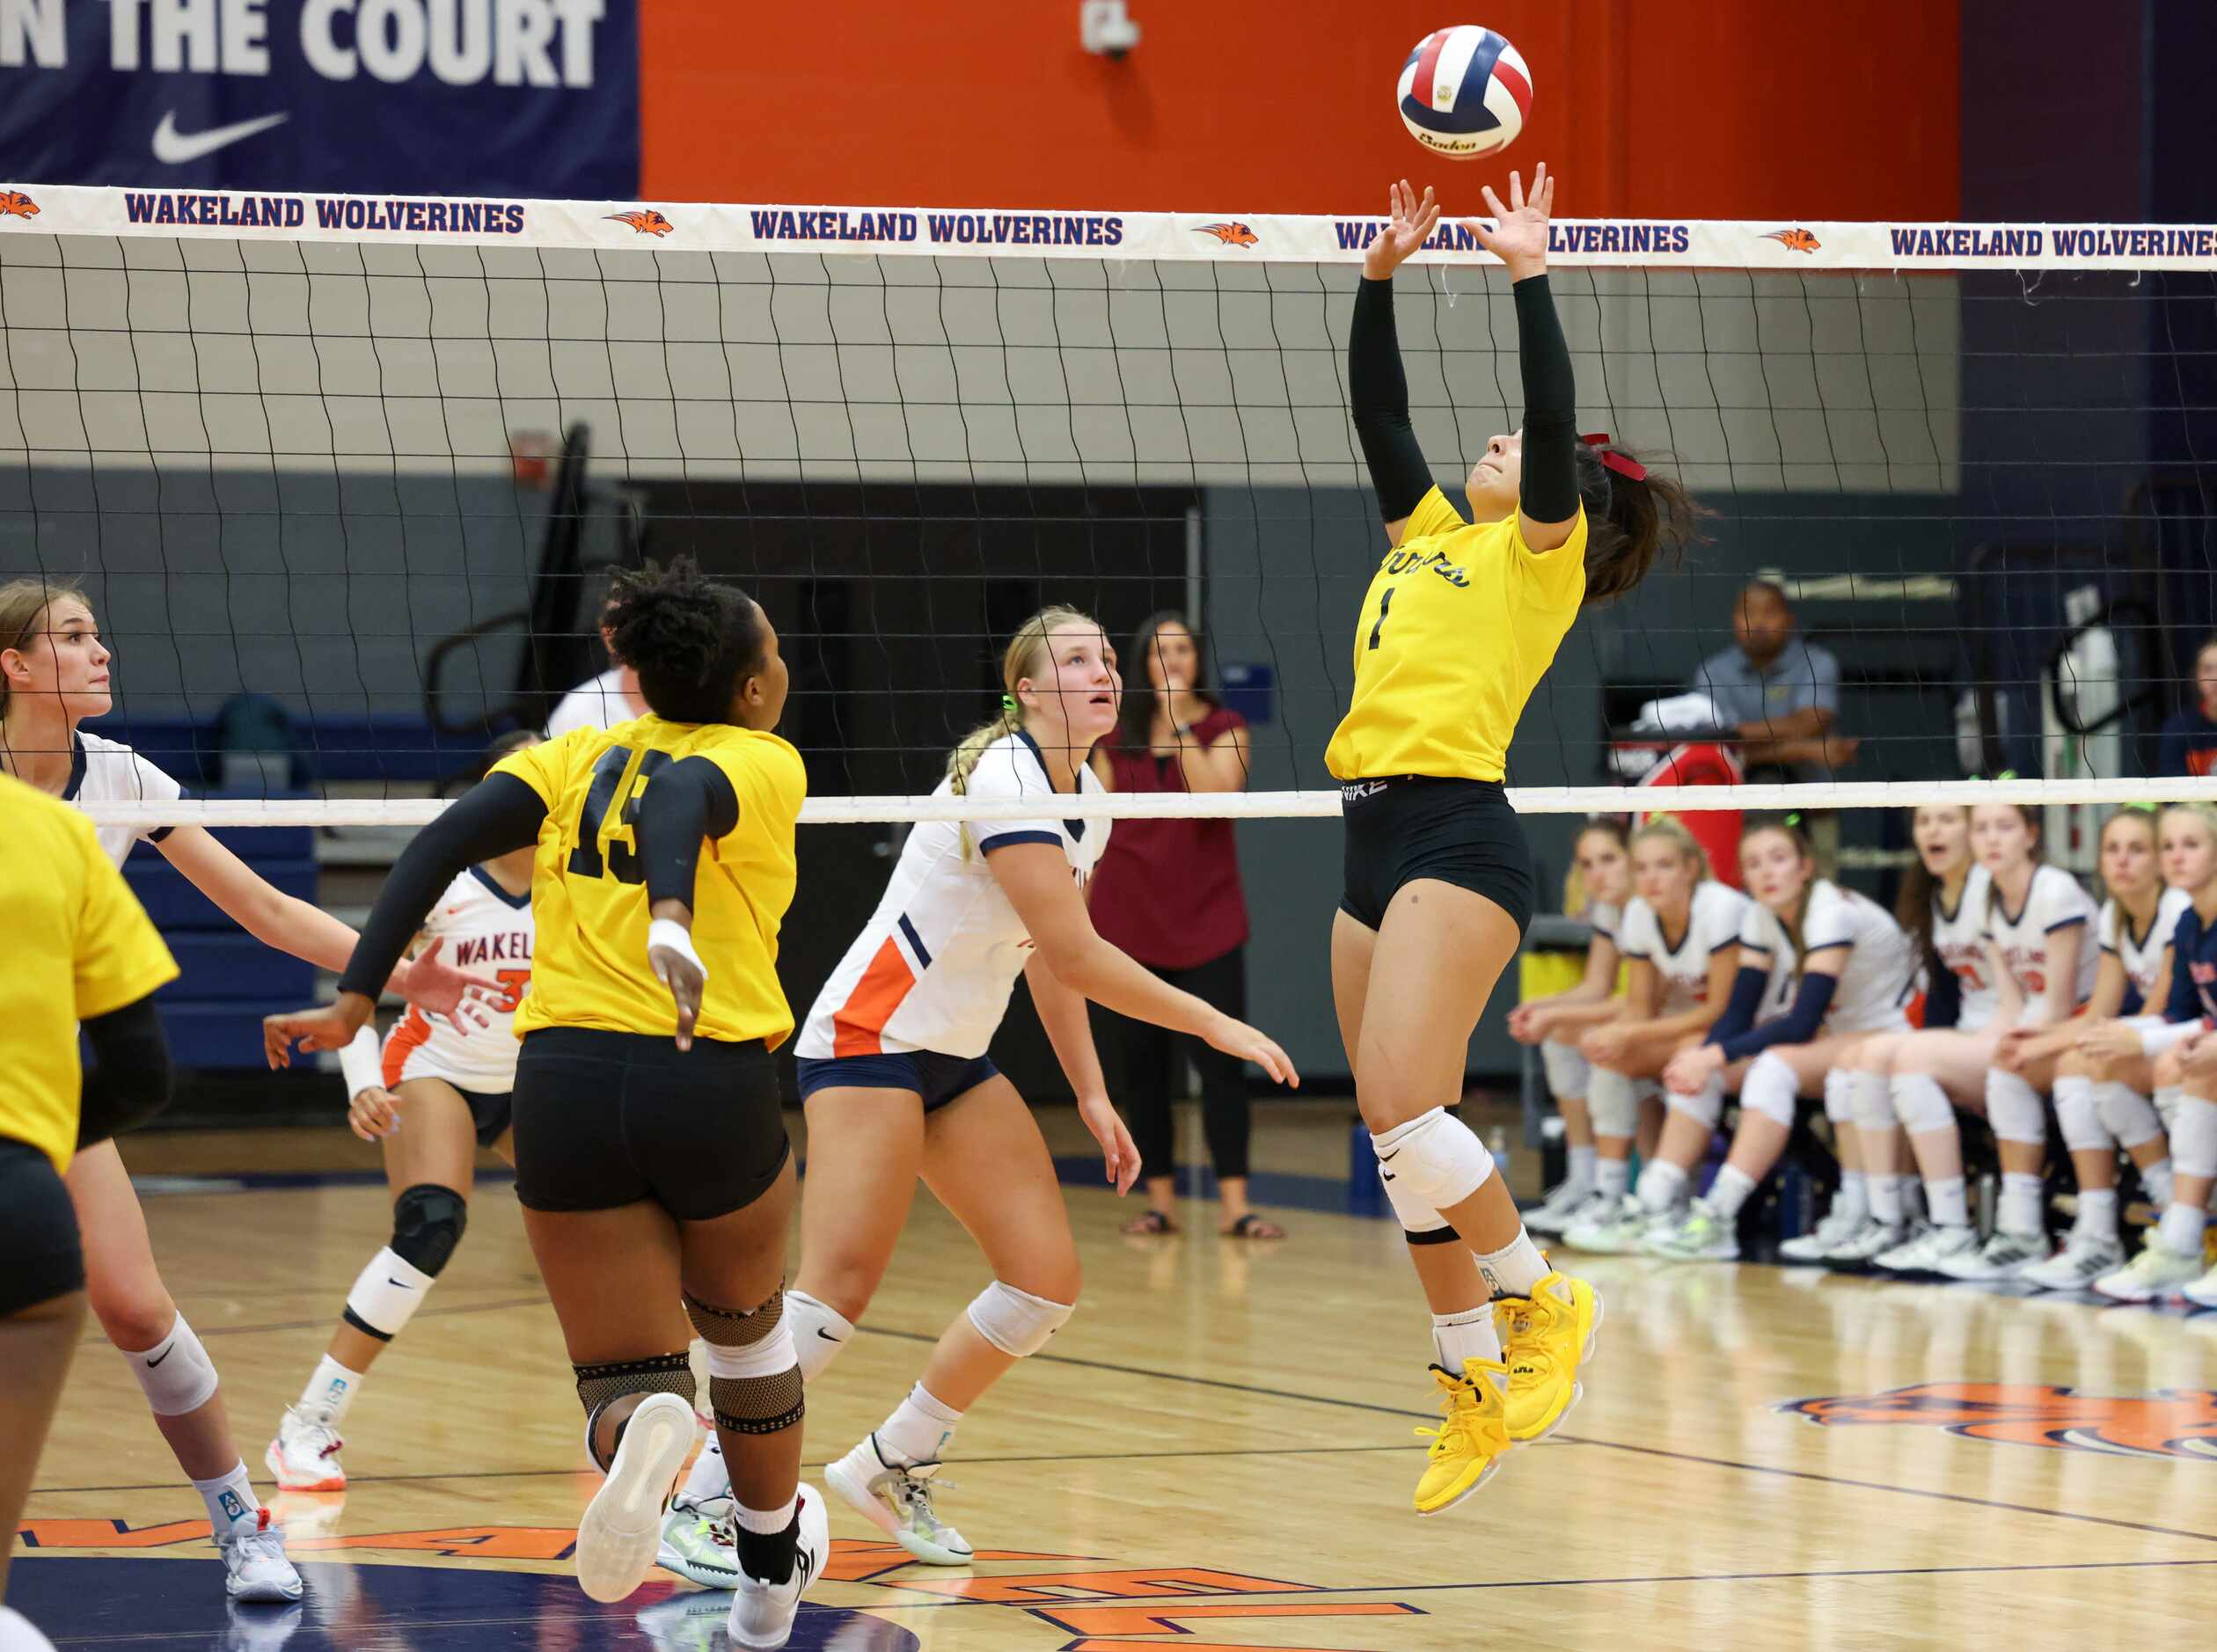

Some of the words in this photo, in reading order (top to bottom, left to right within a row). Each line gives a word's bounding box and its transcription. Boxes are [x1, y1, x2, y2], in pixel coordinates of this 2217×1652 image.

[99, 0, 270, 76] THE
[300, 0, 606, 87] COURT
[125, 194, 304, 227] WAKELAND
[315, 199, 525, 234] WOLVERINES
[750, 211, 918, 241] WAKELAND
[927, 215, 1123, 245] WOLVERINES
[1548, 225, 1689, 252] LVERINES
[1891, 229, 2043, 256] WAKELAND
[2052, 229, 2217, 256] WOLVERINE
[1369, 587, 1395, 650] 1
[1342, 780, 1387, 801] NIKE
[457, 932, 531, 966] WAKEL
